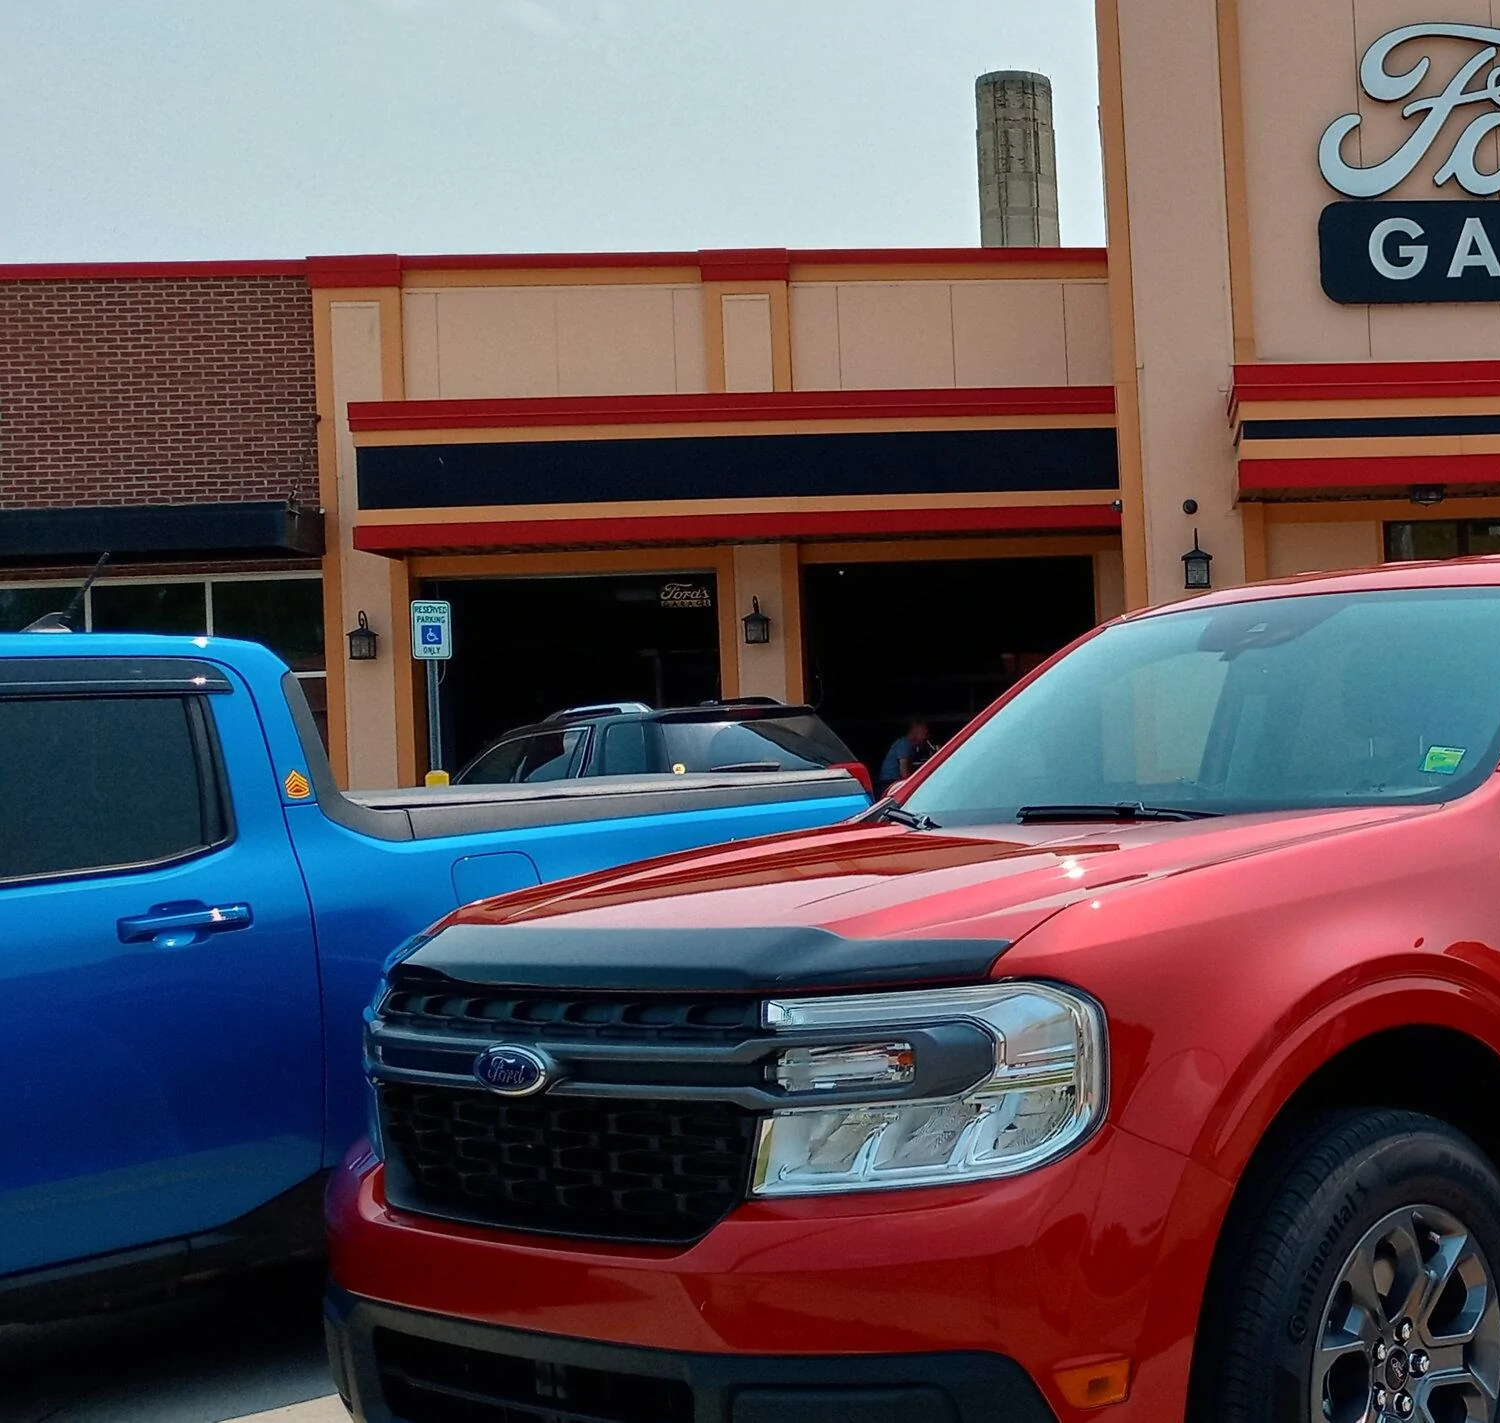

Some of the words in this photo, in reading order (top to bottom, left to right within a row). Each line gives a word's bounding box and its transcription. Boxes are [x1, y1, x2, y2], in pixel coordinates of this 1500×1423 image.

[660, 583, 710, 599] Ford's
[414, 605, 447, 614] RESERVED
[416, 615, 446, 624] PARKING
[423, 646, 441, 656] ONLY
[487, 1056, 525, 1085] Ford
